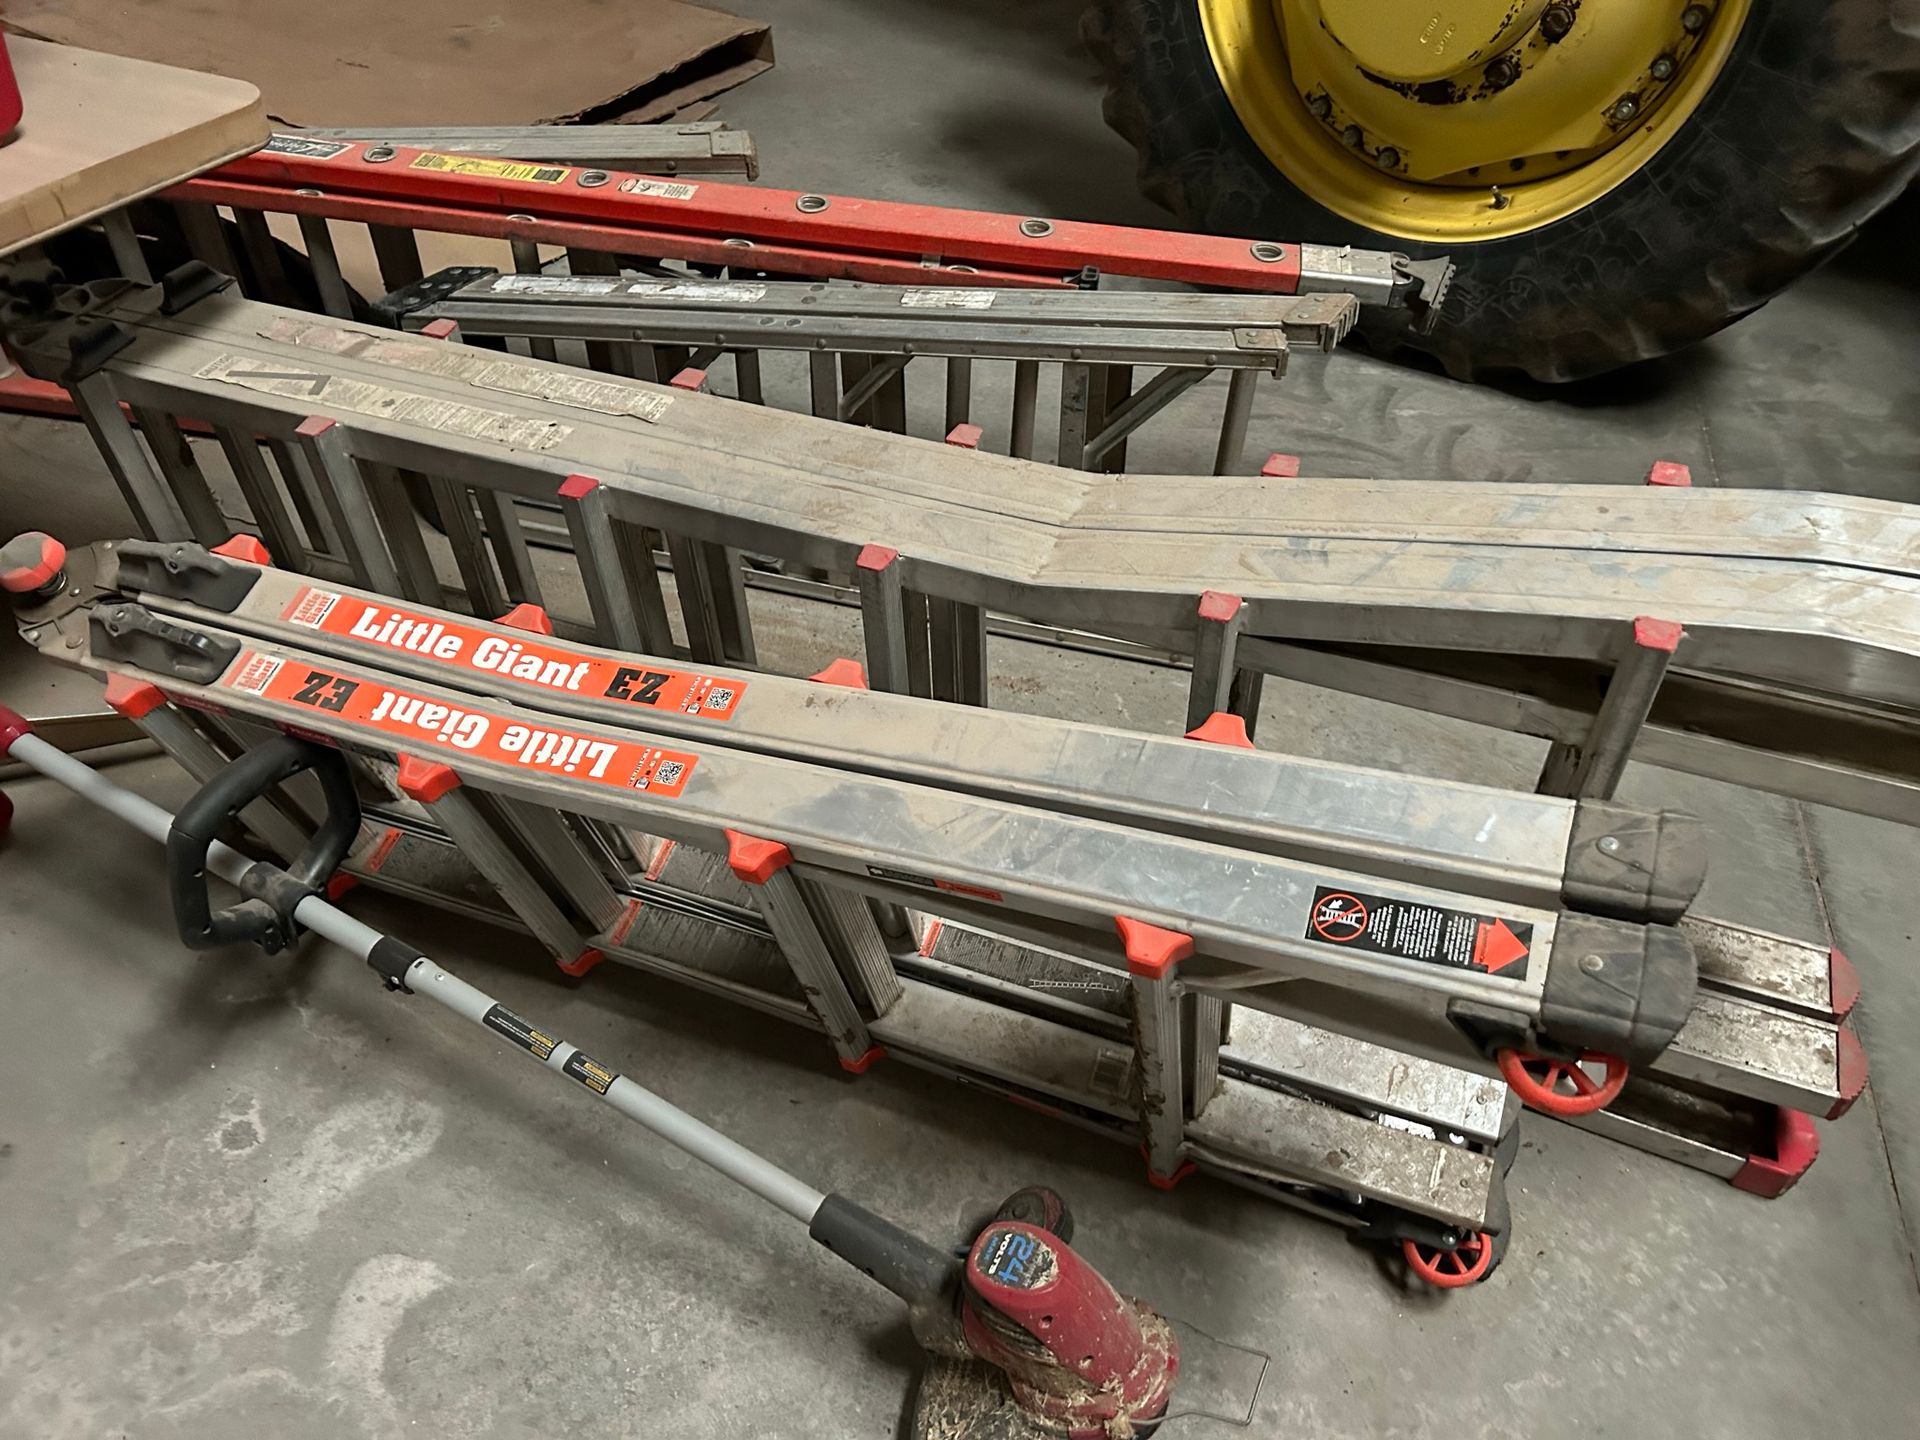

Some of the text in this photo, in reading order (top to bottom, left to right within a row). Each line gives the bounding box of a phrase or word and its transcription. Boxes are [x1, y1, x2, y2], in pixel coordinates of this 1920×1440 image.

[294, 592, 321, 622] Little
[305, 595, 332, 625] Giant
[350, 606, 464, 659] Little
[471, 637, 590, 691] Giant
[293, 670, 360, 713] EZ
[603, 666, 671, 705] EZ
[370, 691, 490, 749] Giant
[499, 724, 619, 778] Little
[988, 1233, 1013, 1274] VOLTS
[998, 1235, 1035, 1282] 24
